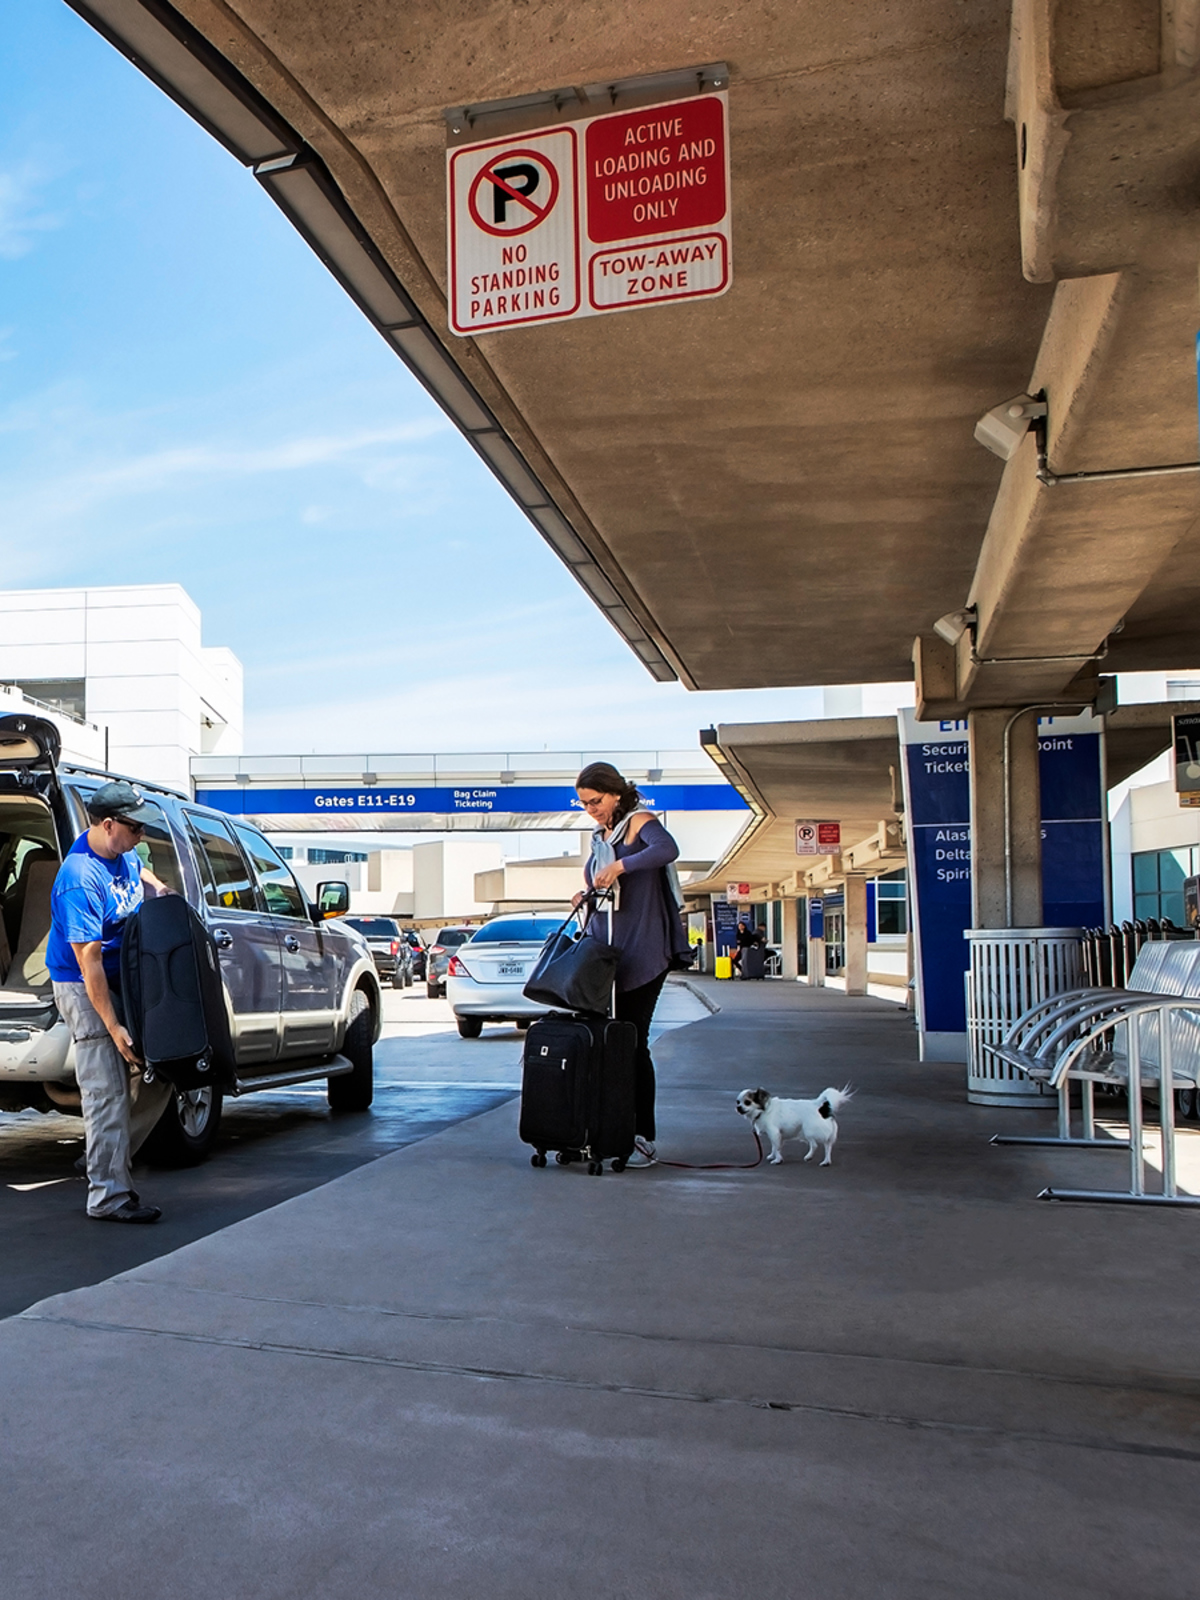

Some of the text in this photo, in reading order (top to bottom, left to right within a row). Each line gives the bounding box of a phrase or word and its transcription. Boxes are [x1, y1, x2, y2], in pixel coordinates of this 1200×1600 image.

[624, 118, 683, 146] ACTIVE
[595, 138, 716, 178] LOADING AND
[604, 166, 707, 202] UNLOADING
[633, 198, 679, 223] ONLY
[502, 244, 527, 265] NO
[600, 243, 718, 277] TOW-AWAY
[471, 262, 560, 295] STANDING
[627, 271, 688, 295] ZONE
[471, 287, 560, 319] PARKING
[922, 743, 969, 757] Securi
[314, 795, 416, 807] Gates E11-E19
[454, 790, 497, 800] Bag Claim
[454, 800, 493, 809] Ticketing
